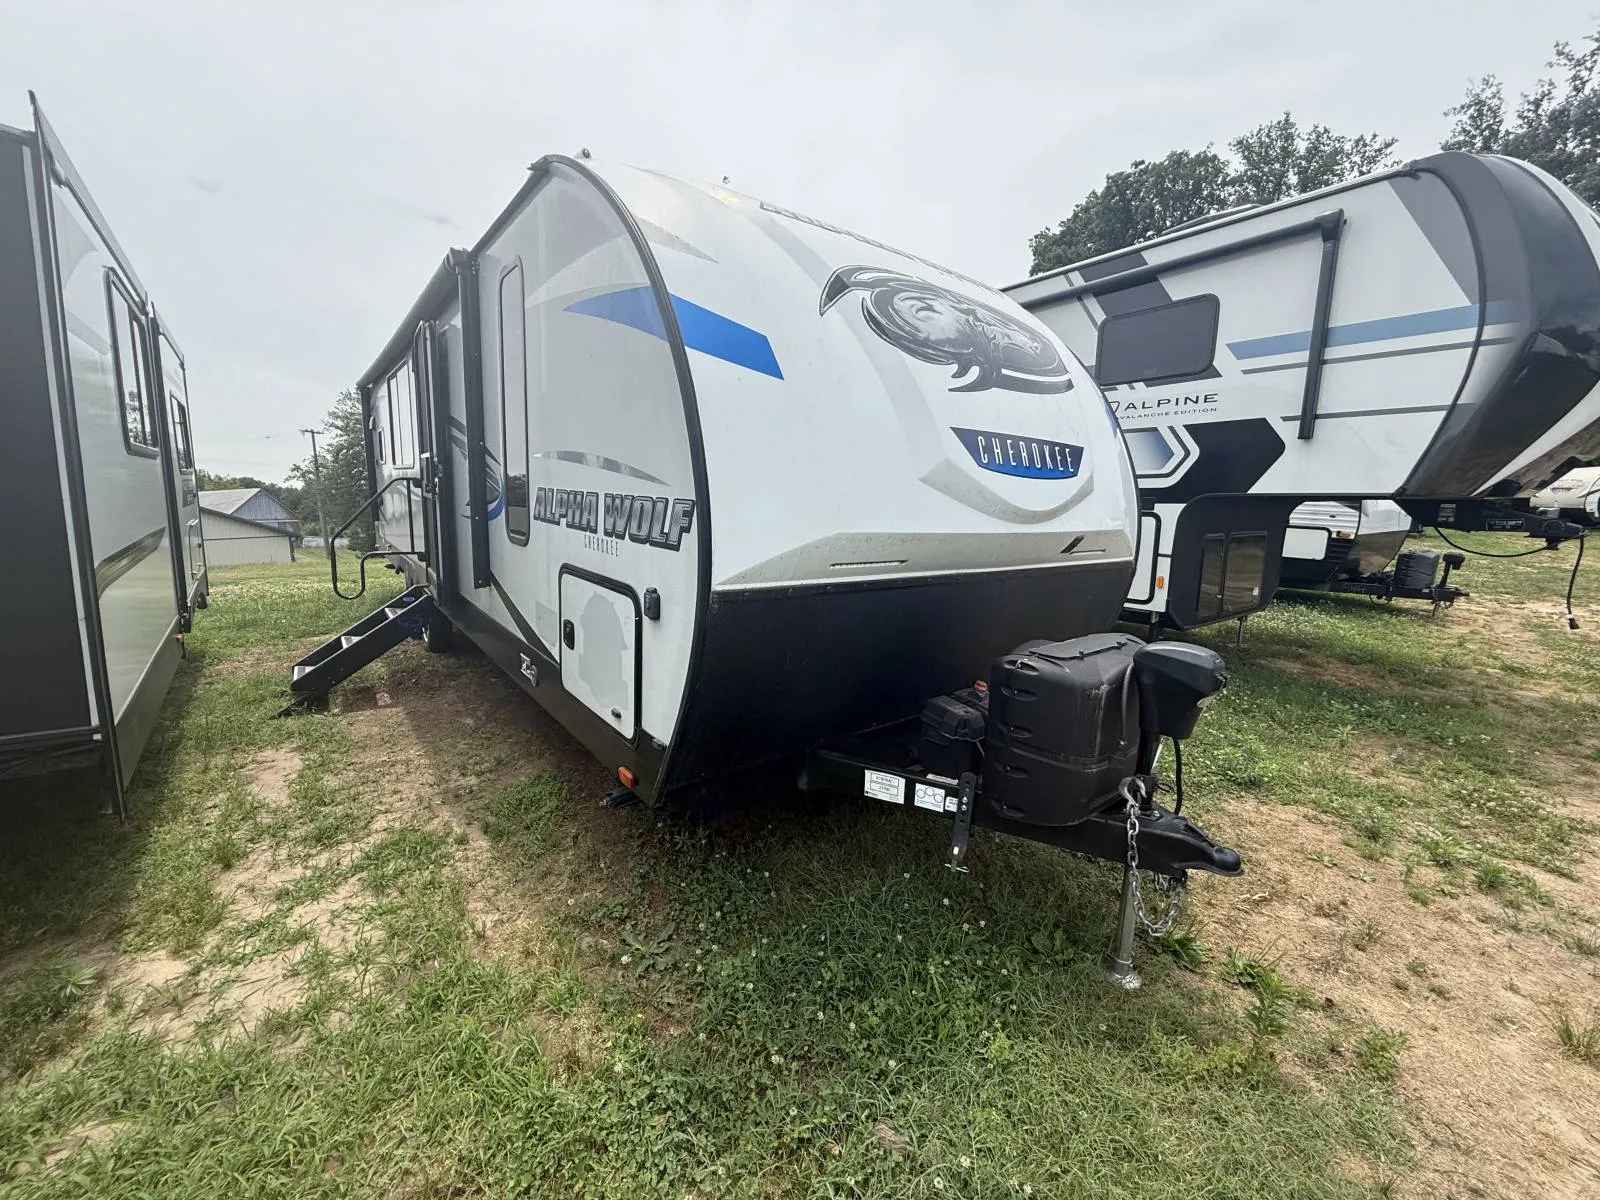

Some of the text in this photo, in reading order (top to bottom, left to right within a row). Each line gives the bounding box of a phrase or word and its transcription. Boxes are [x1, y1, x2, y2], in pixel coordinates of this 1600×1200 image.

[1117, 407, 1217, 419] VALANCHE EDITION
[1124, 393, 1218, 411] ALPINE
[977, 435, 1074, 472] CHEROKEE
[533, 487, 696, 552] ALPHA WOLF
[584, 533, 619, 558] CHEROKEE
